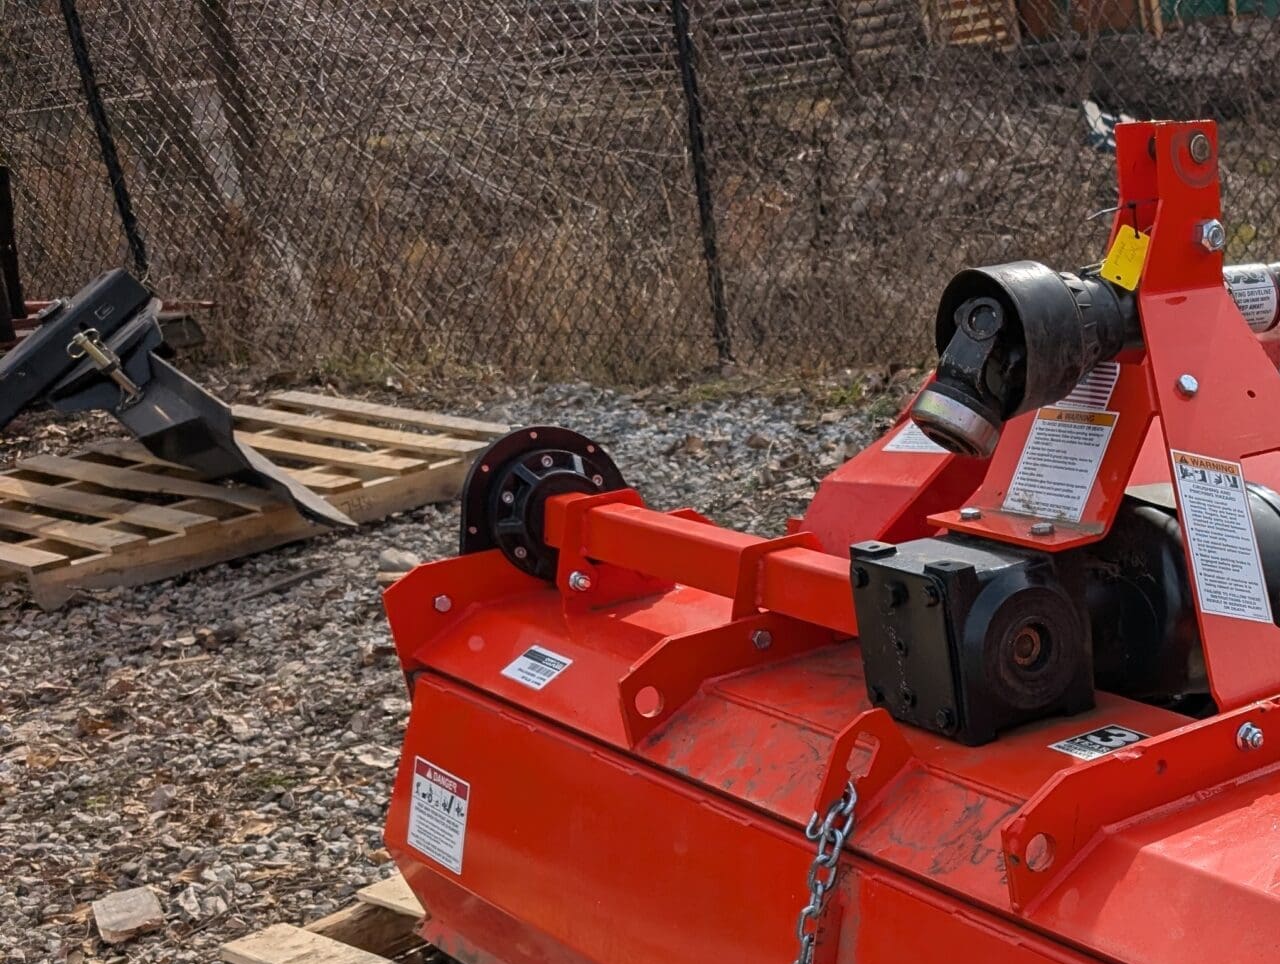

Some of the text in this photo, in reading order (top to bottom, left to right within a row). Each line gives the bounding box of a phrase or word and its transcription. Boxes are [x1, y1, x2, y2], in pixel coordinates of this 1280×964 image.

[1190, 457, 1235, 474] WARNING
[1073, 738, 1111, 754] YEAR
[1087, 728, 1139, 749] 3
[433, 771, 458, 793] DANGER
